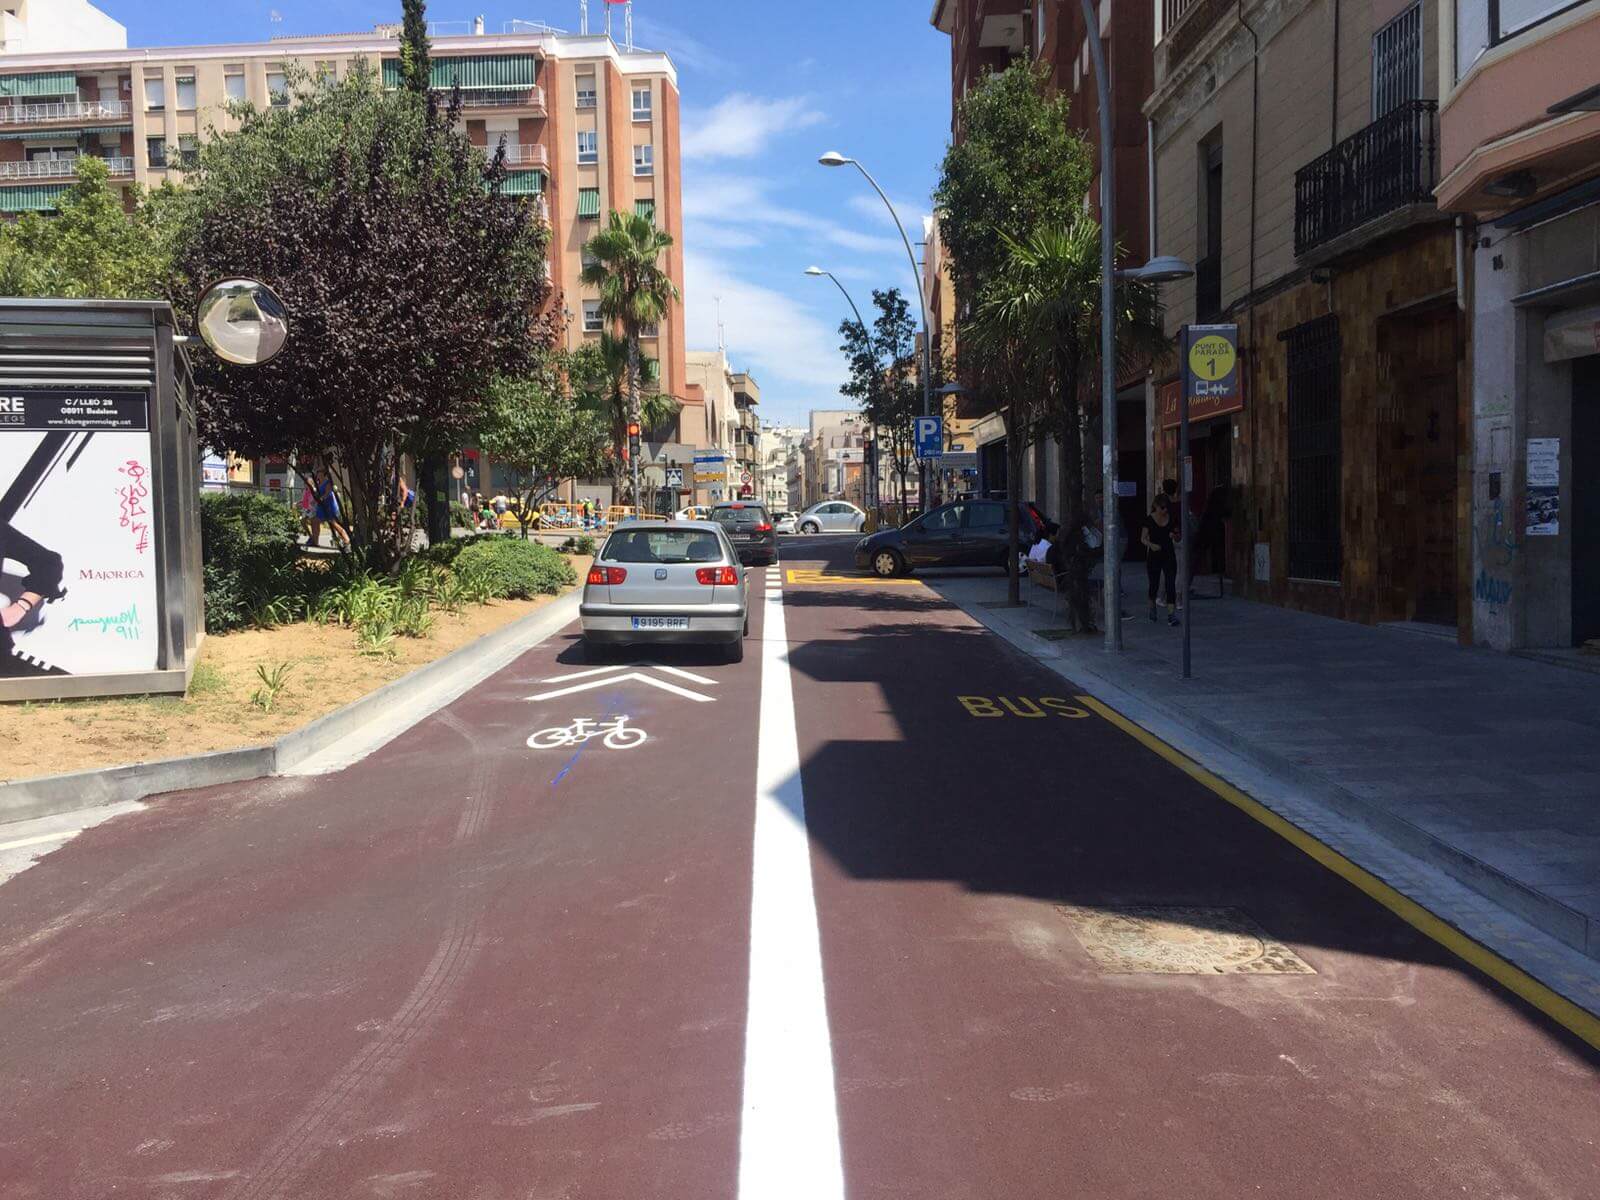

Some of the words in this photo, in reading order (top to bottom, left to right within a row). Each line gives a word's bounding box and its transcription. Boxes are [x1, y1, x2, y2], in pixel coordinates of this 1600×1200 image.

[1206, 358, 1216, 377] 1
[61, 407, 84, 415] 08911
[86, 407, 118, 415] Badalona
[919, 419, 938, 443] P
[640, 618, 664, 627] 9195
[956, 695, 1091, 718] BUS
